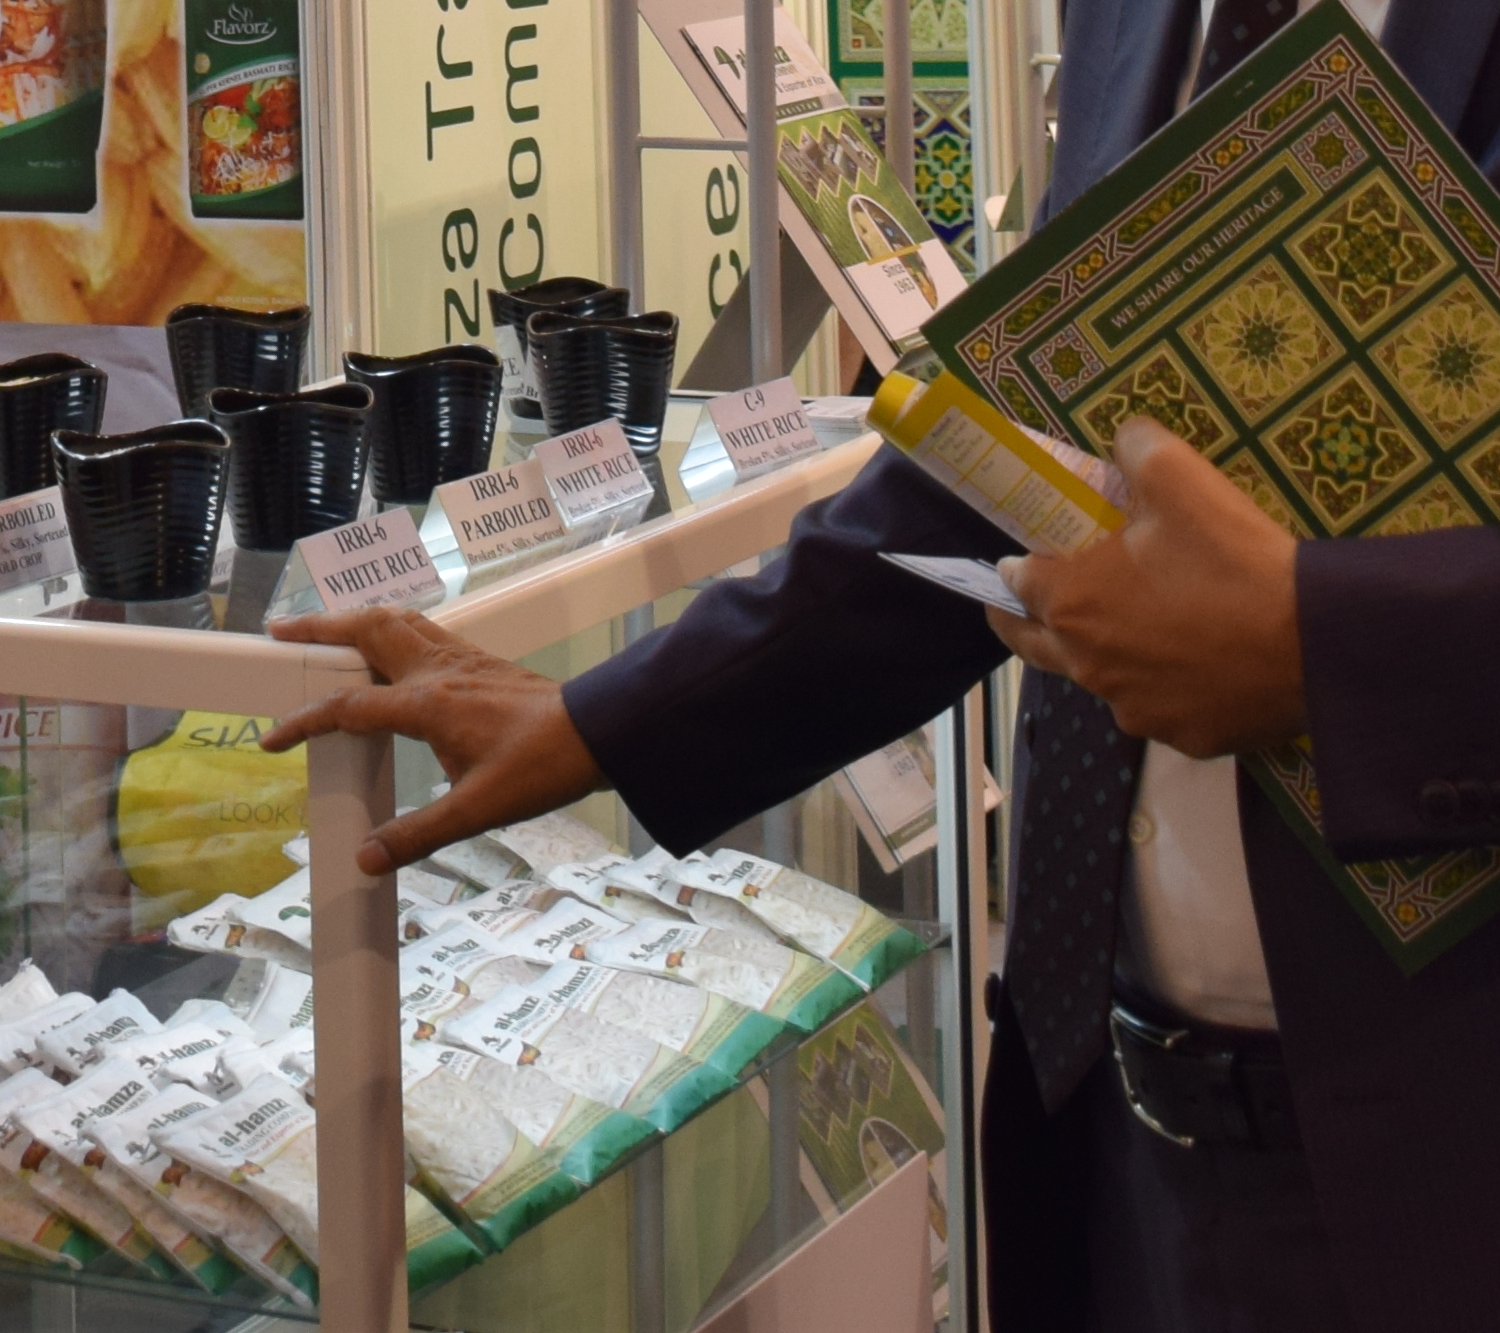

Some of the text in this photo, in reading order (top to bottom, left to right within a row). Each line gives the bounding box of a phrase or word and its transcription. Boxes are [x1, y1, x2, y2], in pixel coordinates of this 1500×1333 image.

[213, 18, 270, 35] Flavorz
[1110, 186, 1285, 330] WE SHARE OUR HERITAGE
[743, 388, 766, 412] C-9
[560, 429, 604, 460] IRRI-6
[725, 410, 808, 450] WHITE RICE
[468, 469, 520, 501] IRRI-6
[555, 452, 637, 496] WHITE RICE
[333, 518, 388, 554] IRRI-6
[459, 497, 551, 542] PARBOILED
[19, 551, 44, 569] CROP
[322, 544, 429, 597] WHITE RICE
[184, 717, 268, 751] SIA
[219, 800, 294, 824] LOOK
